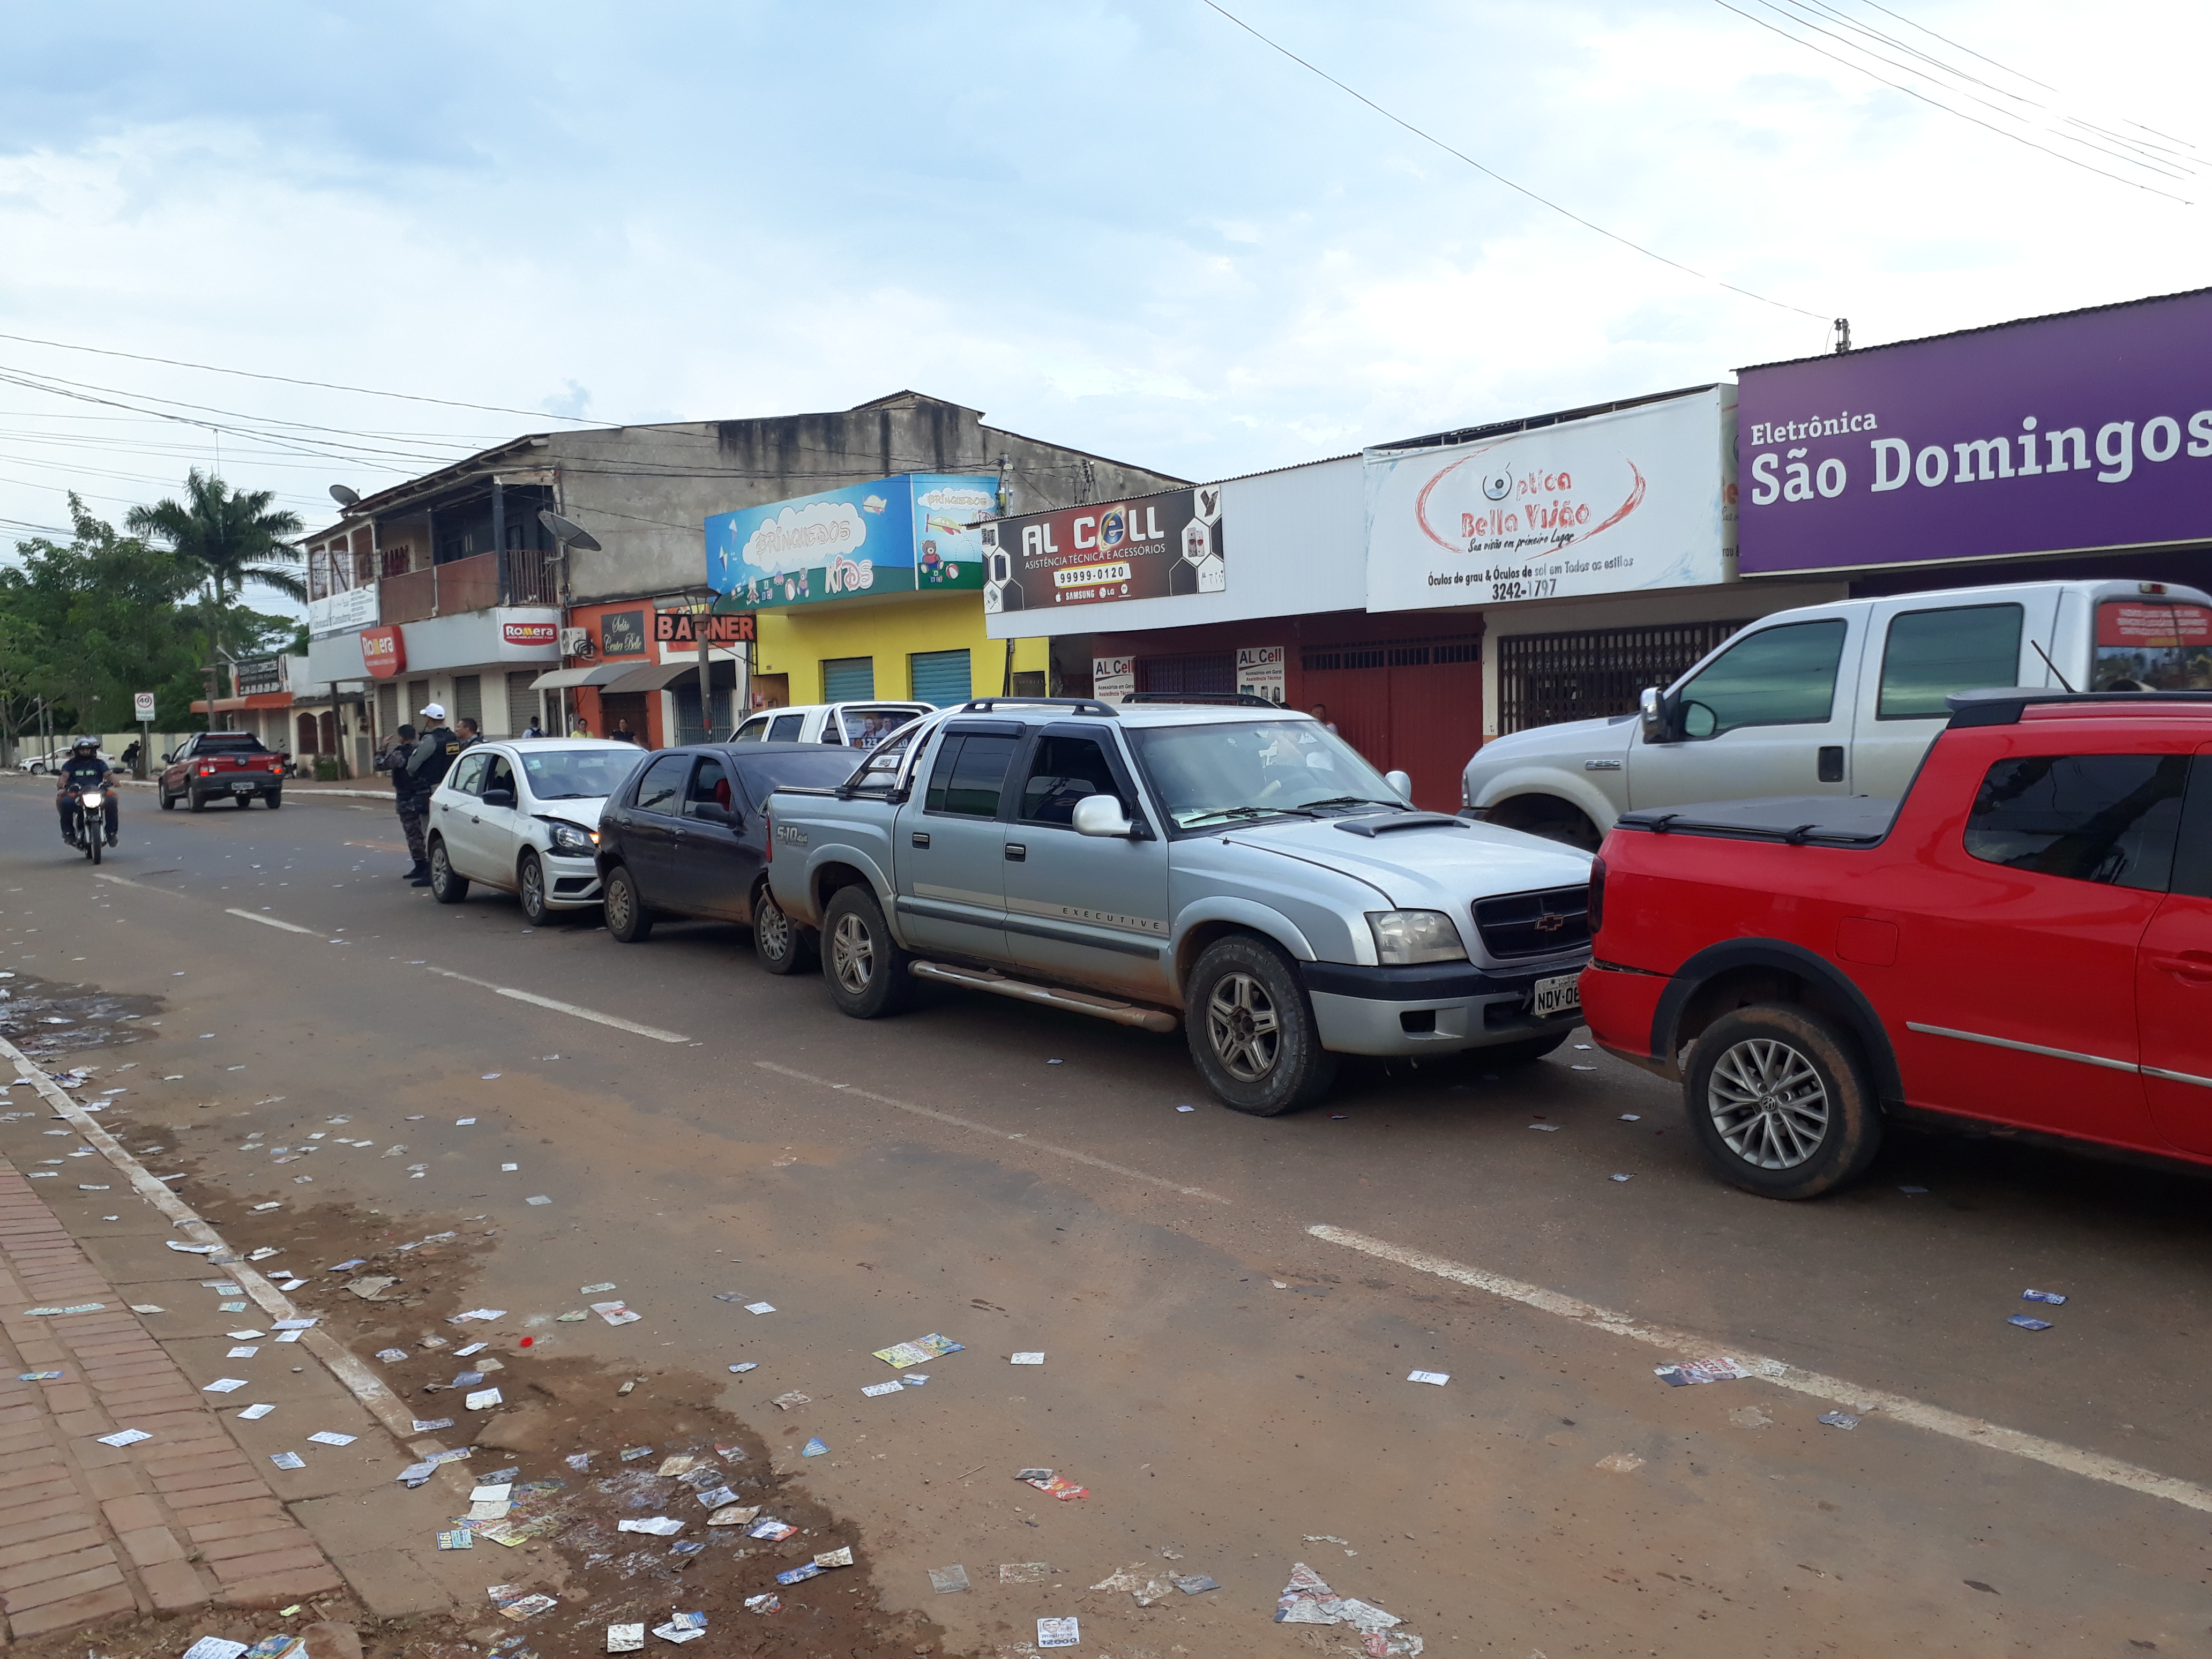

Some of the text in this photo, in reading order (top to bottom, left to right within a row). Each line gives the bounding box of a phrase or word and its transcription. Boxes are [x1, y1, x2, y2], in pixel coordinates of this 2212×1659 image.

[1751, 411, 1877, 446] Eletrônica
[1752, 410, 2212, 505] São Domingos
[1461, 509, 1518, 537] Bella
[1022, 523, 1058, 557] AL
[1504, 540, 1514, 548] em
[1515, 533, 1548, 552] primeiro
[1025, 556, 1067, 570] ASISTÊNCIA
[1068, 552, 1105, 564] TÉCNICA
[1112, 543, 1165, 559] ACESSÓRIOS
[1060, 566, 1123, 584] 99999-0120
[1428, 571, 1452, 586] Óculos
[1454, 572, 1463, 584] de
[1465, 573, 1483, 586] grau
[1485, 570, 1491, 582] &
[1493, 564, 1519, 580] Óculos
[1522, 565, 1532, 577] de
[1535, 564, 1546, 577] sol
[1550, 567, 1561, 575] em
[1565, 559, 1589, 573] Todos
[1065, 589, 1095, 601] SAMSUNG
[1492, 578, 1557, 601] 3242-1797
[1096, 659, 1134, 675] AL Cell
[1239, 648, 1281, 664] AL Cell
[1063, 908, 1159, 929] EXECUTIVE
